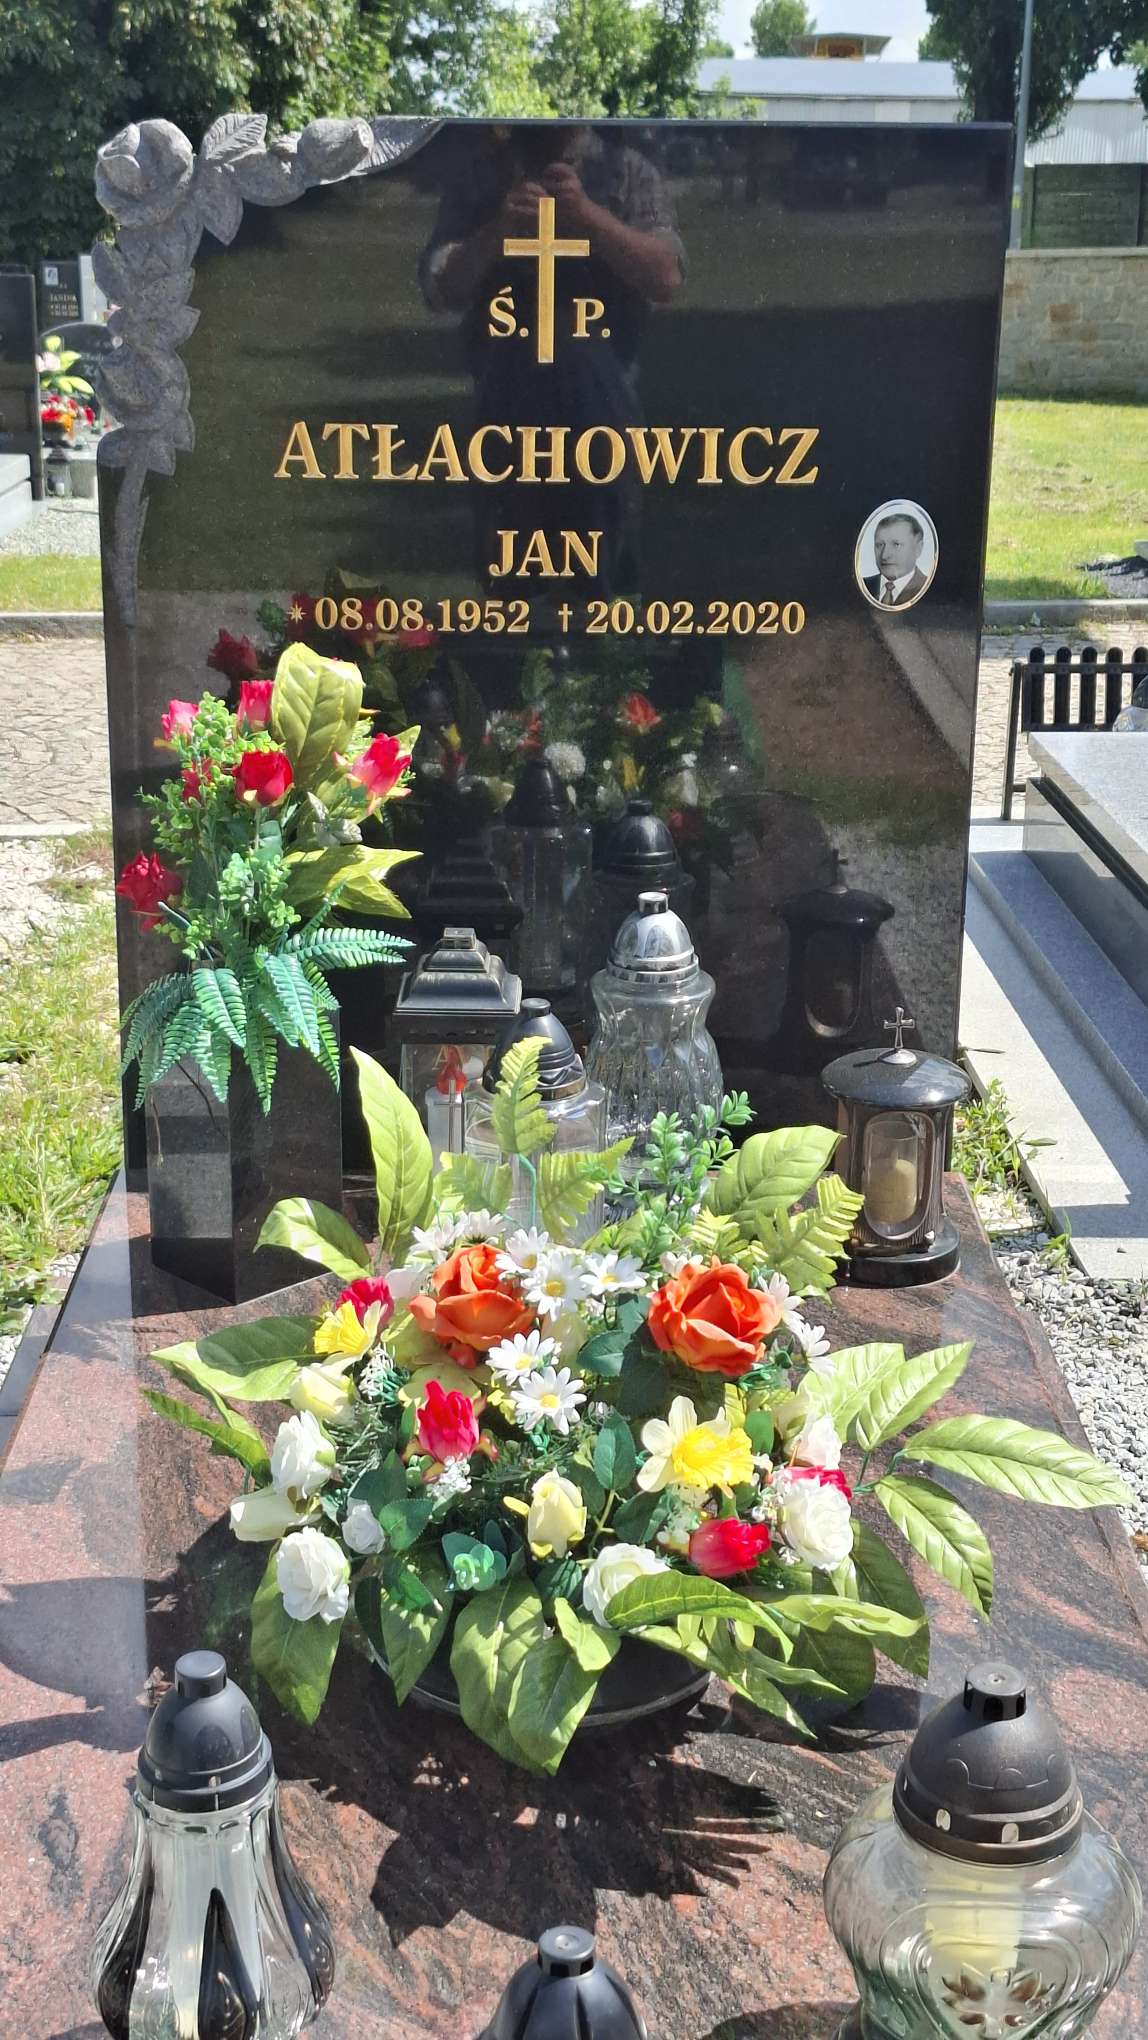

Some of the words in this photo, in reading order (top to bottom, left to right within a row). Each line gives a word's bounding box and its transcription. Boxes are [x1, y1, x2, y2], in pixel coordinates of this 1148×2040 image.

[488, 286, 528, 337] Ś.
[572, 297, 610, 338] P.
[273, 420, 820, 485] ATŁACHOWICZ
[488, 529, 603, 577] JAN
[314, 597, 530, 633] 08.08.1952
[586, 599, 806, 635] 20.02.2020
